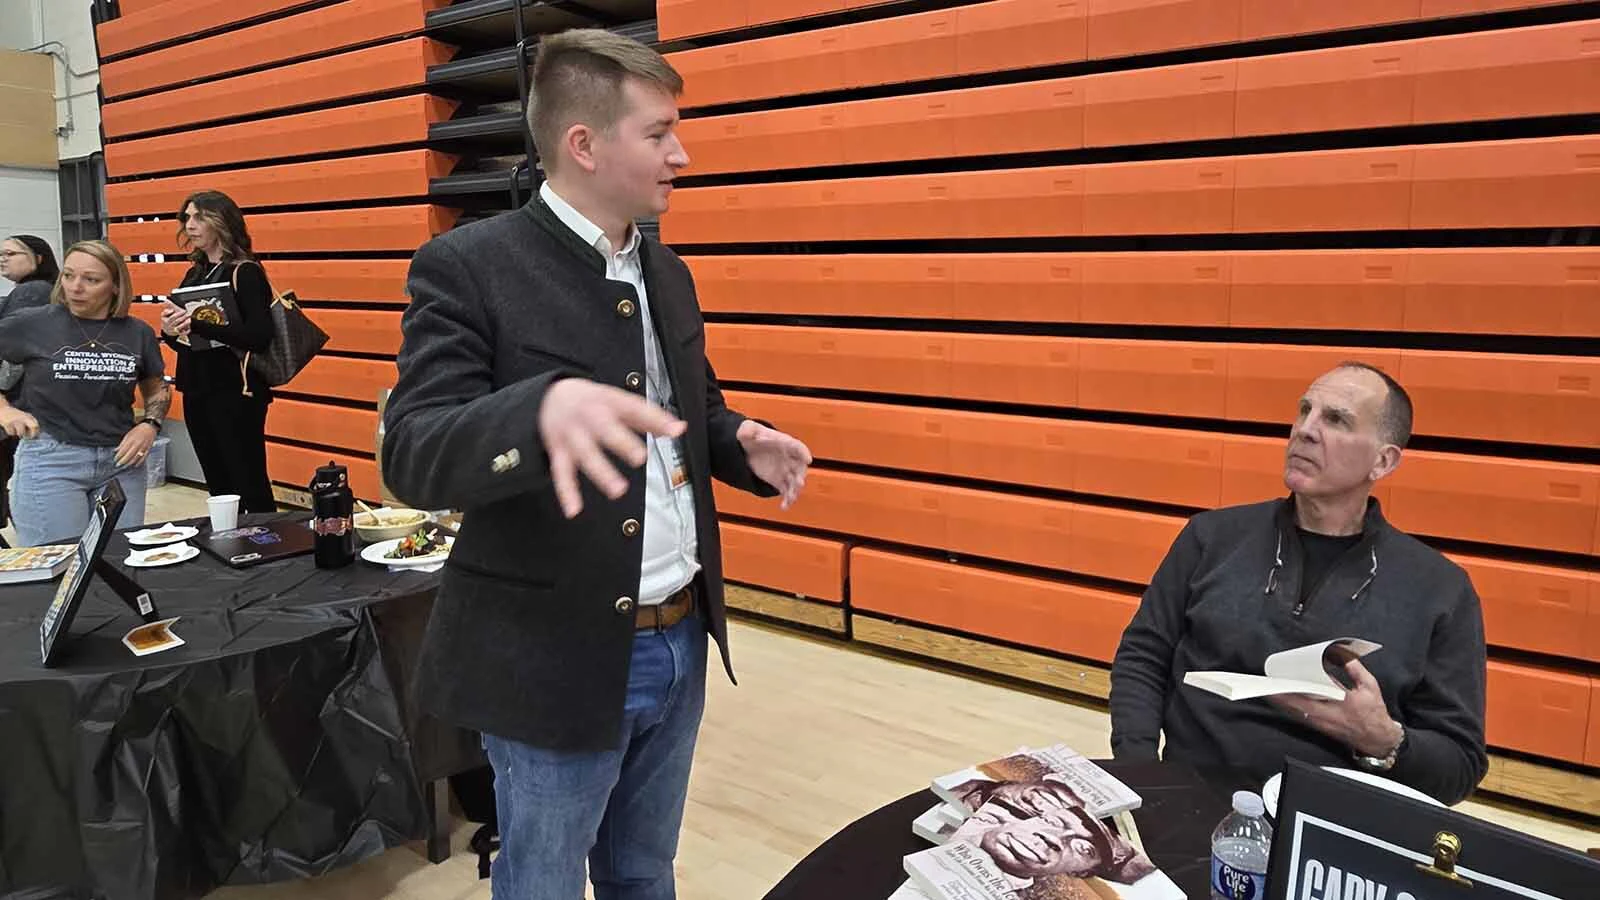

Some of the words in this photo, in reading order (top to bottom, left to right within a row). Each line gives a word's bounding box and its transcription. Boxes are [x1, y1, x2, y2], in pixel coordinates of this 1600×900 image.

[65, 357, 127, 366] INNOVATION
[953, 843, 972, 859] Who
[968, 857, 993, 879] Owns
[989, 876, 1006, 891] the
[1223, 864, 1250, 884] Pure
[1226, 875, 1247, 893] Life
